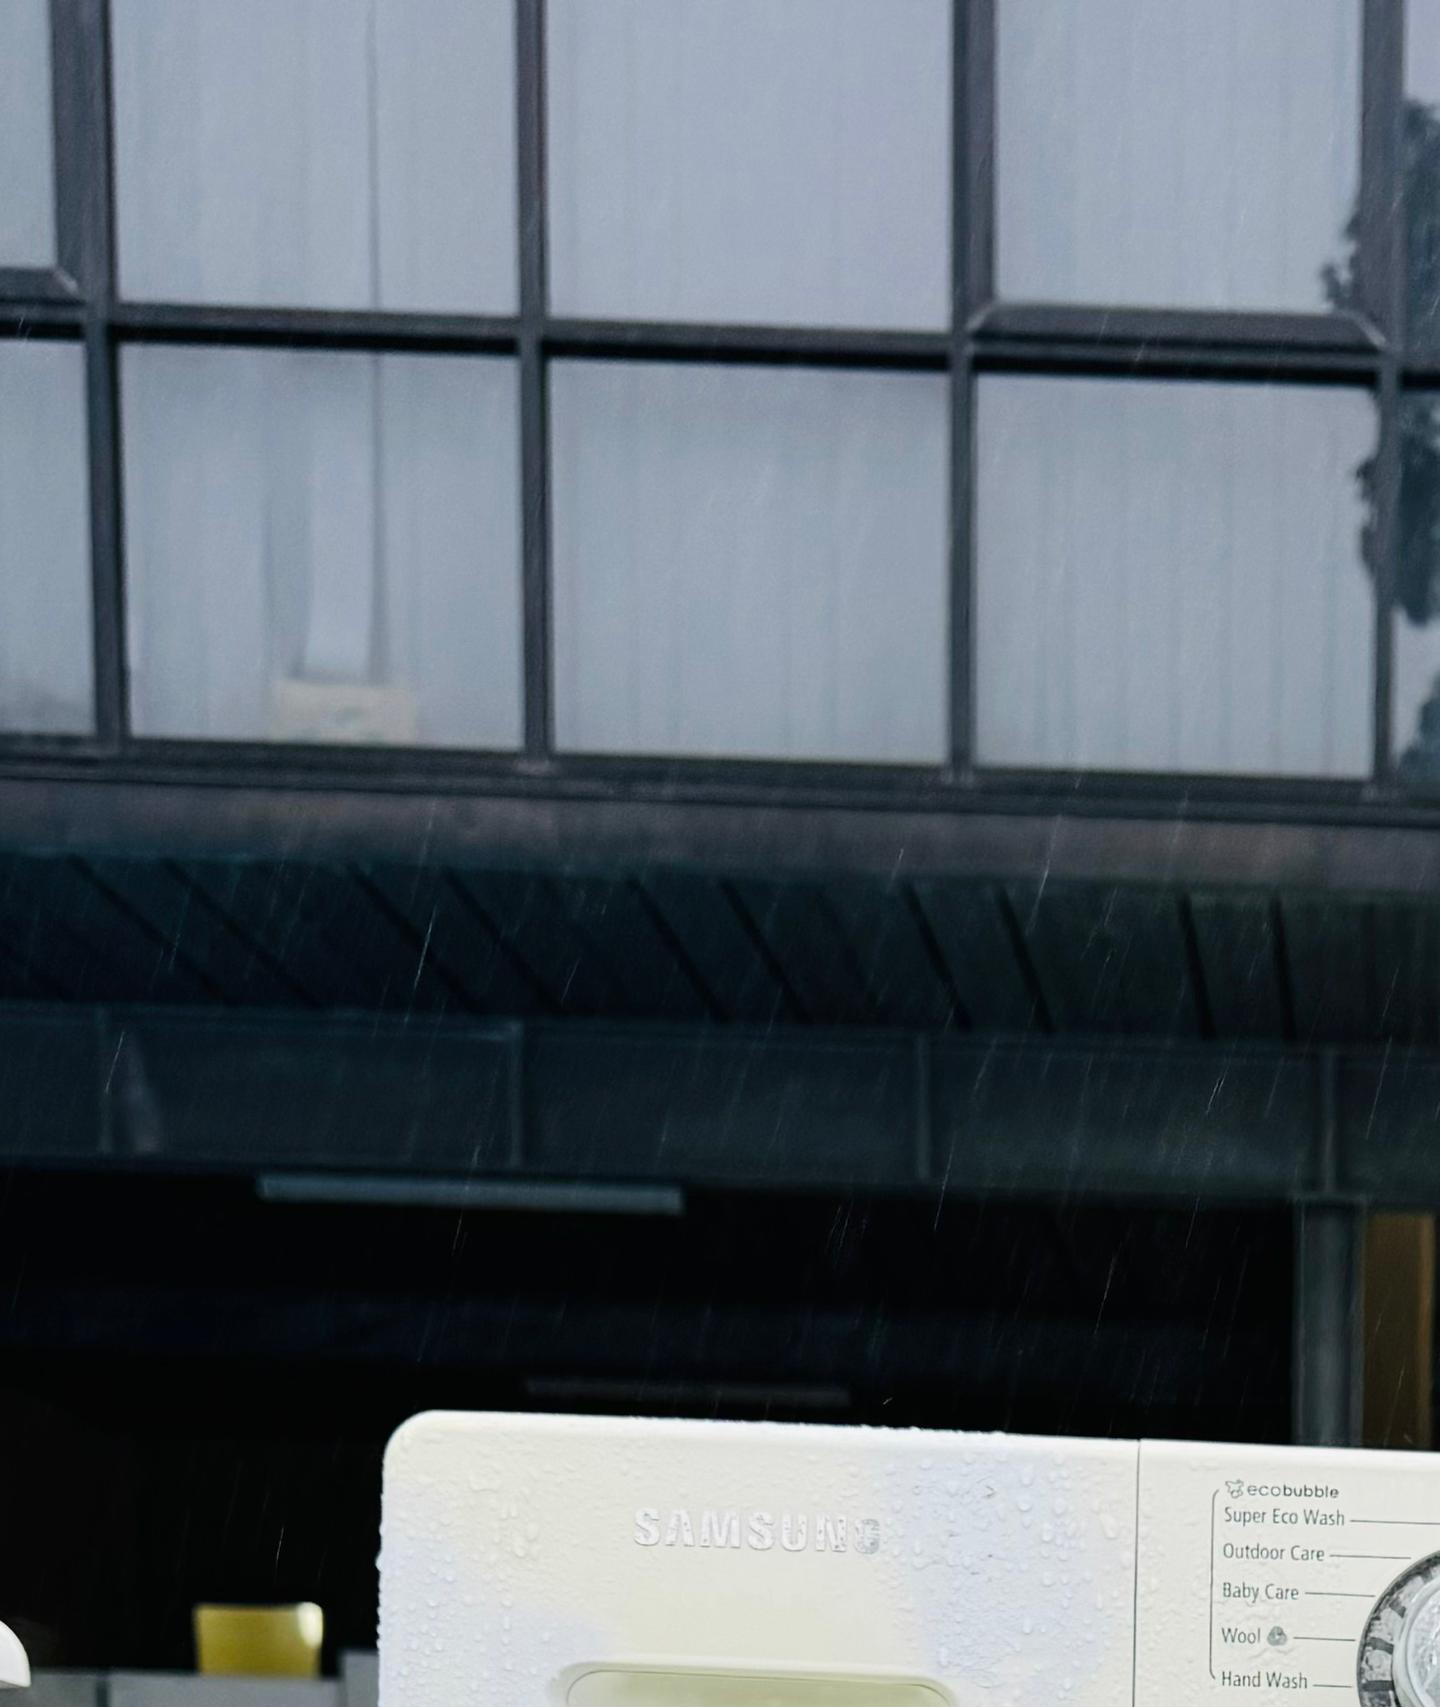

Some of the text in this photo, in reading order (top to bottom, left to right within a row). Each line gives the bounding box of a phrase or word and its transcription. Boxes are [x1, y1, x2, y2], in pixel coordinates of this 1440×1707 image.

[1247, 1484, 1339, 1499] ecobubble
[1224, 1506, 1344, 1527] Super Eco Wash
[633, 1507, 881, 1554] SAMSUNG
[1223, 1542, 1325, 1562] Outdoor Care
[1221, 1581, 1299, 1606] Baby Care
[1221, 1627, 1261, 1645] Wool
[1222, 1670, 1307, 1689] Hand Wash
